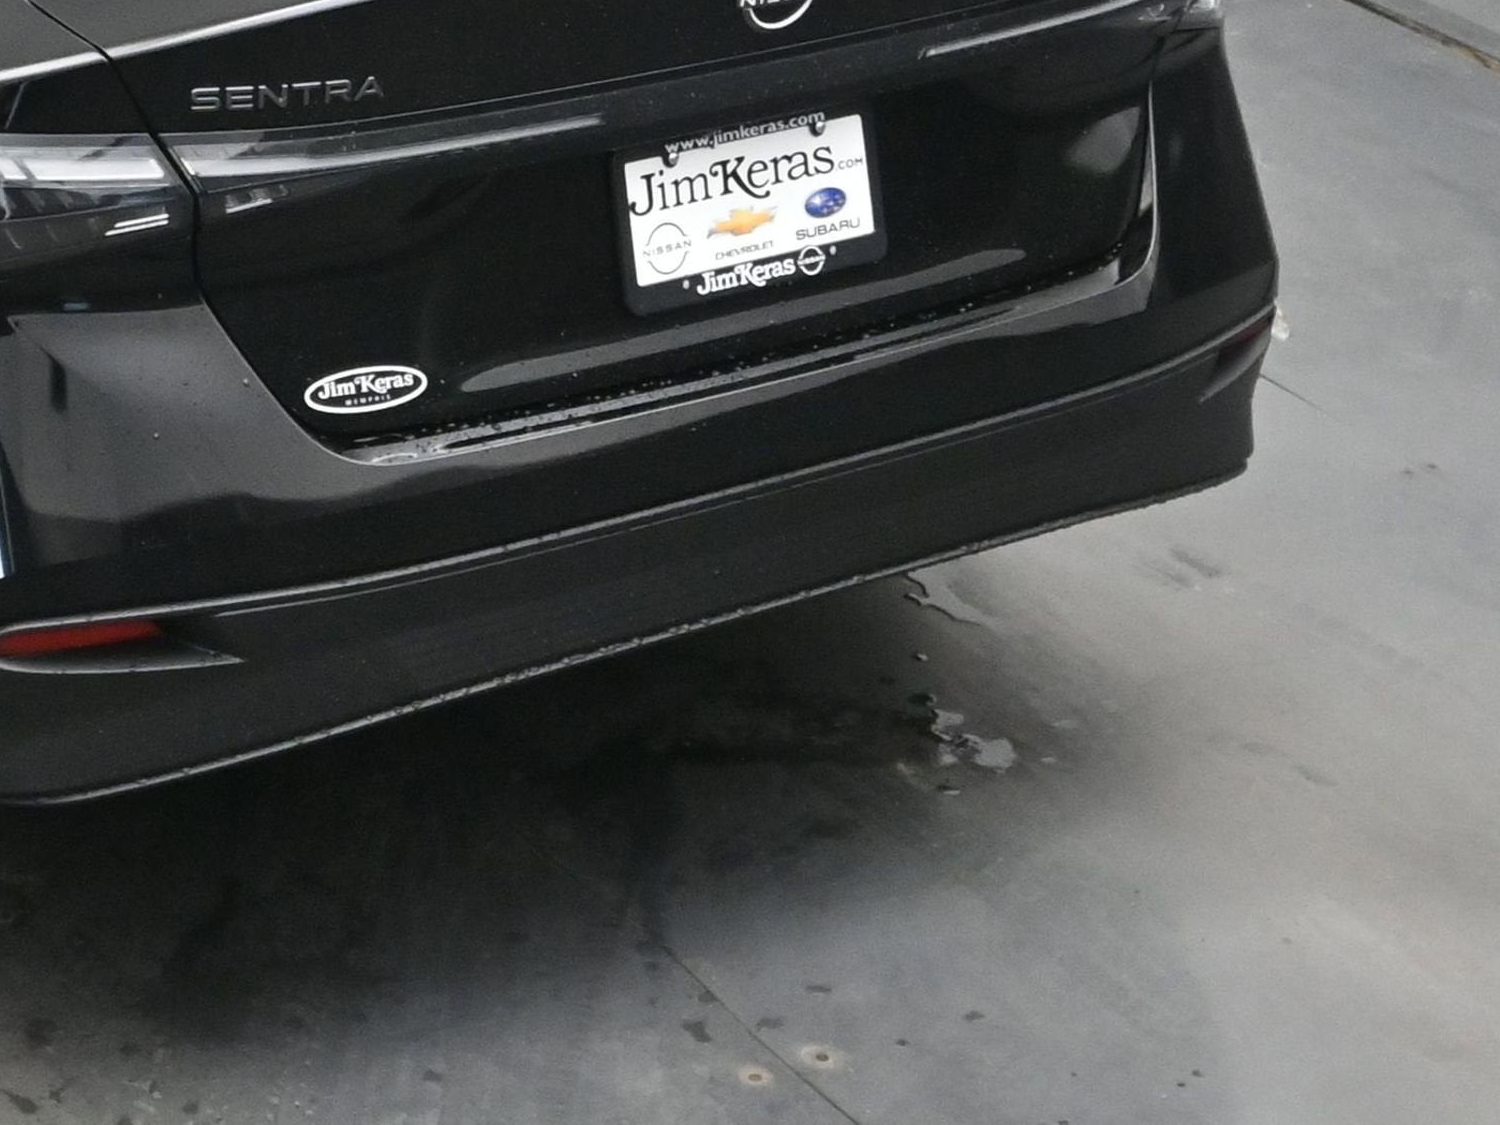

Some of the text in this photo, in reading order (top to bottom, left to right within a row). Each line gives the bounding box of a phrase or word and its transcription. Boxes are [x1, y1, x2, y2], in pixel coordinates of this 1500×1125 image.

[190, 76, 384, 110] SENTRA
[664, 111, 826, 154] www.jimkeras.com
[796, 217, 860, 240] SUBARU
[643, 239, 692, 257] NISSAN
